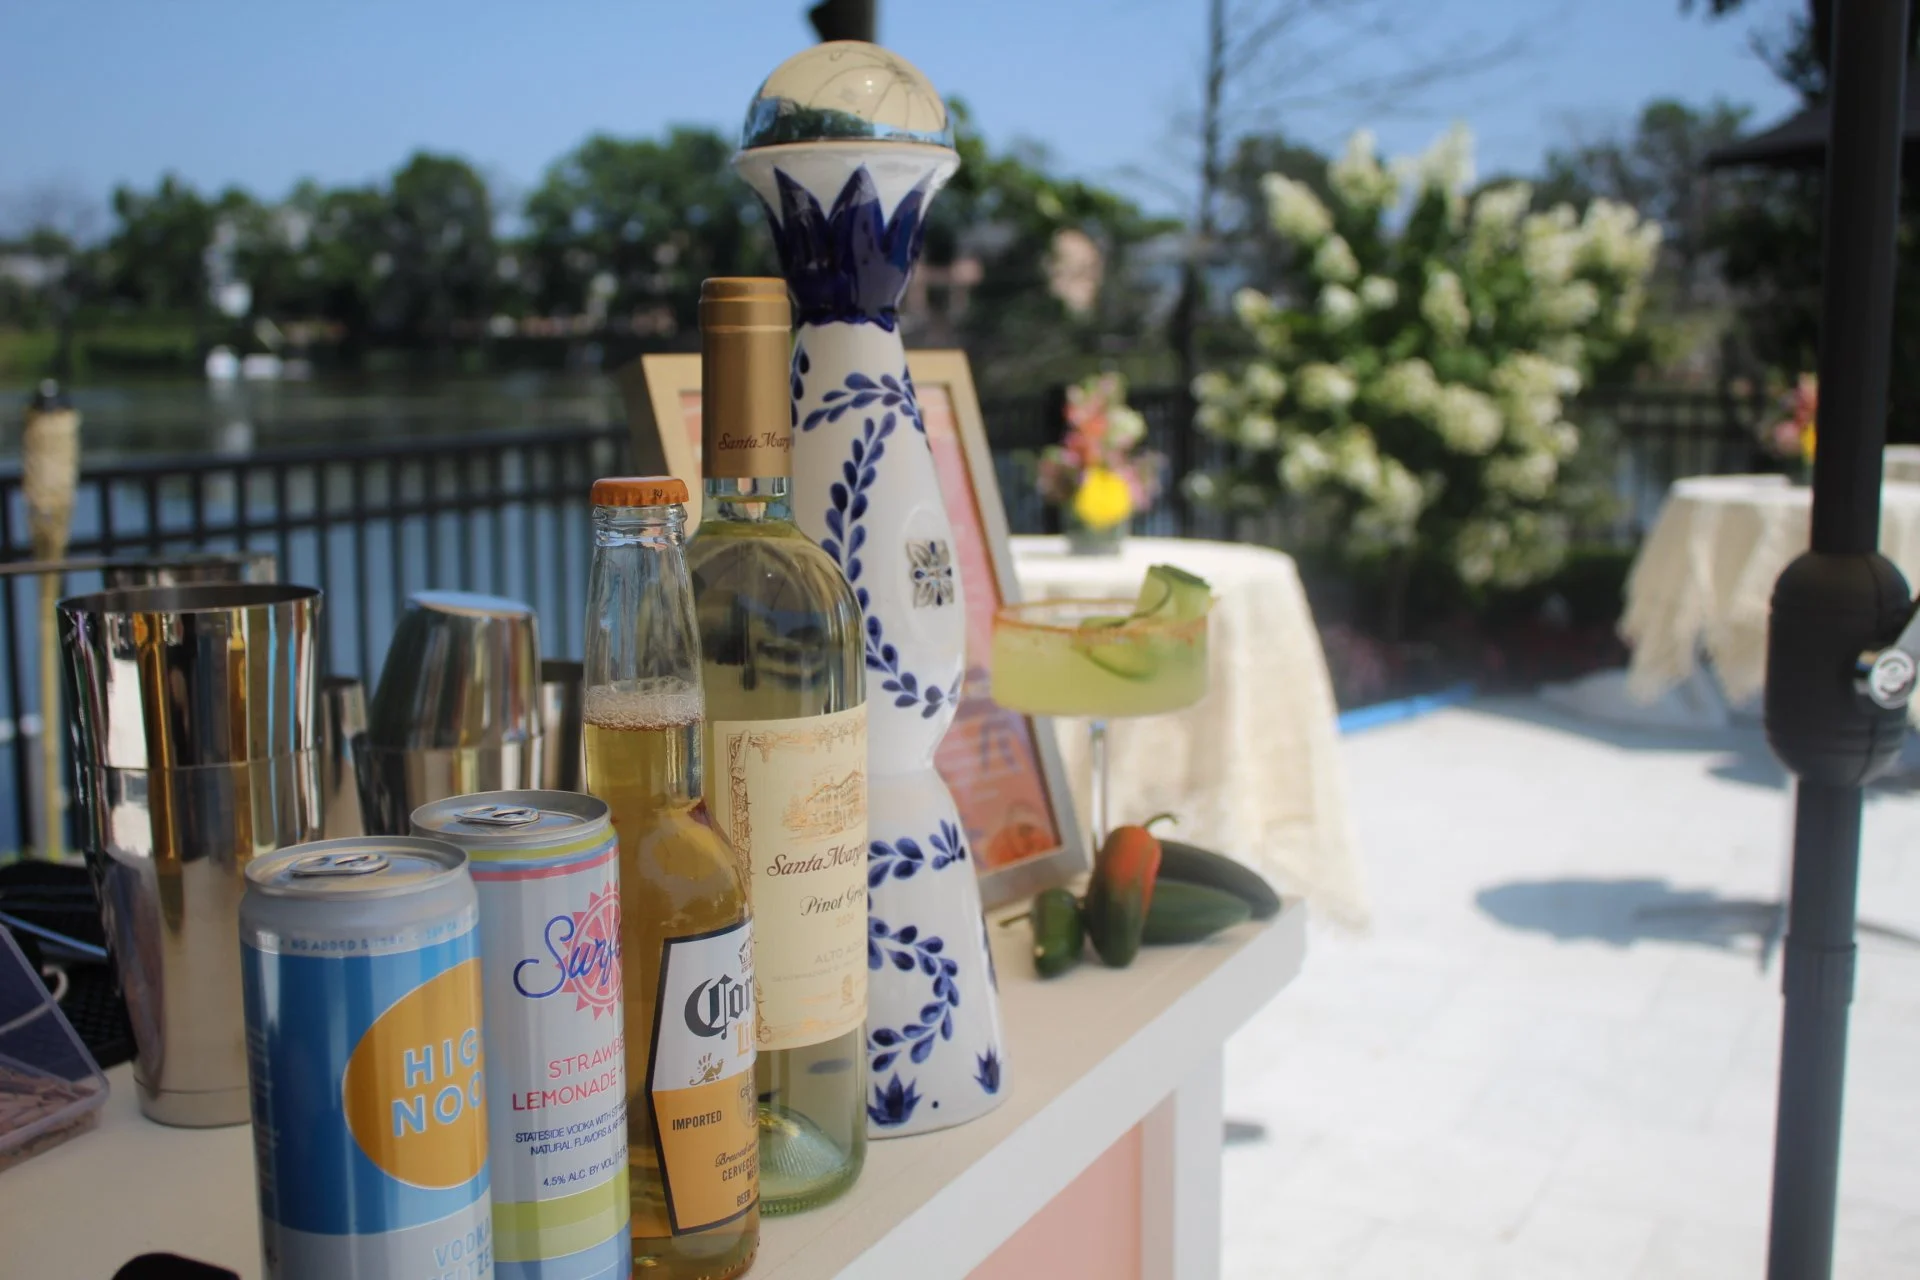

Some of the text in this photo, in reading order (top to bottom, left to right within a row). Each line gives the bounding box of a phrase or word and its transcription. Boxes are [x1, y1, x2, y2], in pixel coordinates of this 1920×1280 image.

[718, 432, 757, 451] Santa
[767, 841, 867, 877] Santa Marg
[800, 891, 844, 917] Pinot
[311, 939, 357, 951] ADDED
[815, 948, 844, 966] ALTO
[512, 1067, 617, 1111] LEMONADE
[515, 1127, 565, 1143] STATESIDE
[567, 1119, 595, 1135] VODKA
[595, 1111, 612, 1126] WITH
[672, 1110, 722, 1131] IMPORTED
[530, 1140, 573, 1156] NATURAL
[574, 1127, 607, 1148] FLAVORS
[543, 1172, 567, 1187] 4.5%
[568, 1168, 588, 1183] ALC.
[589, 1163, 600, 1176] BY
